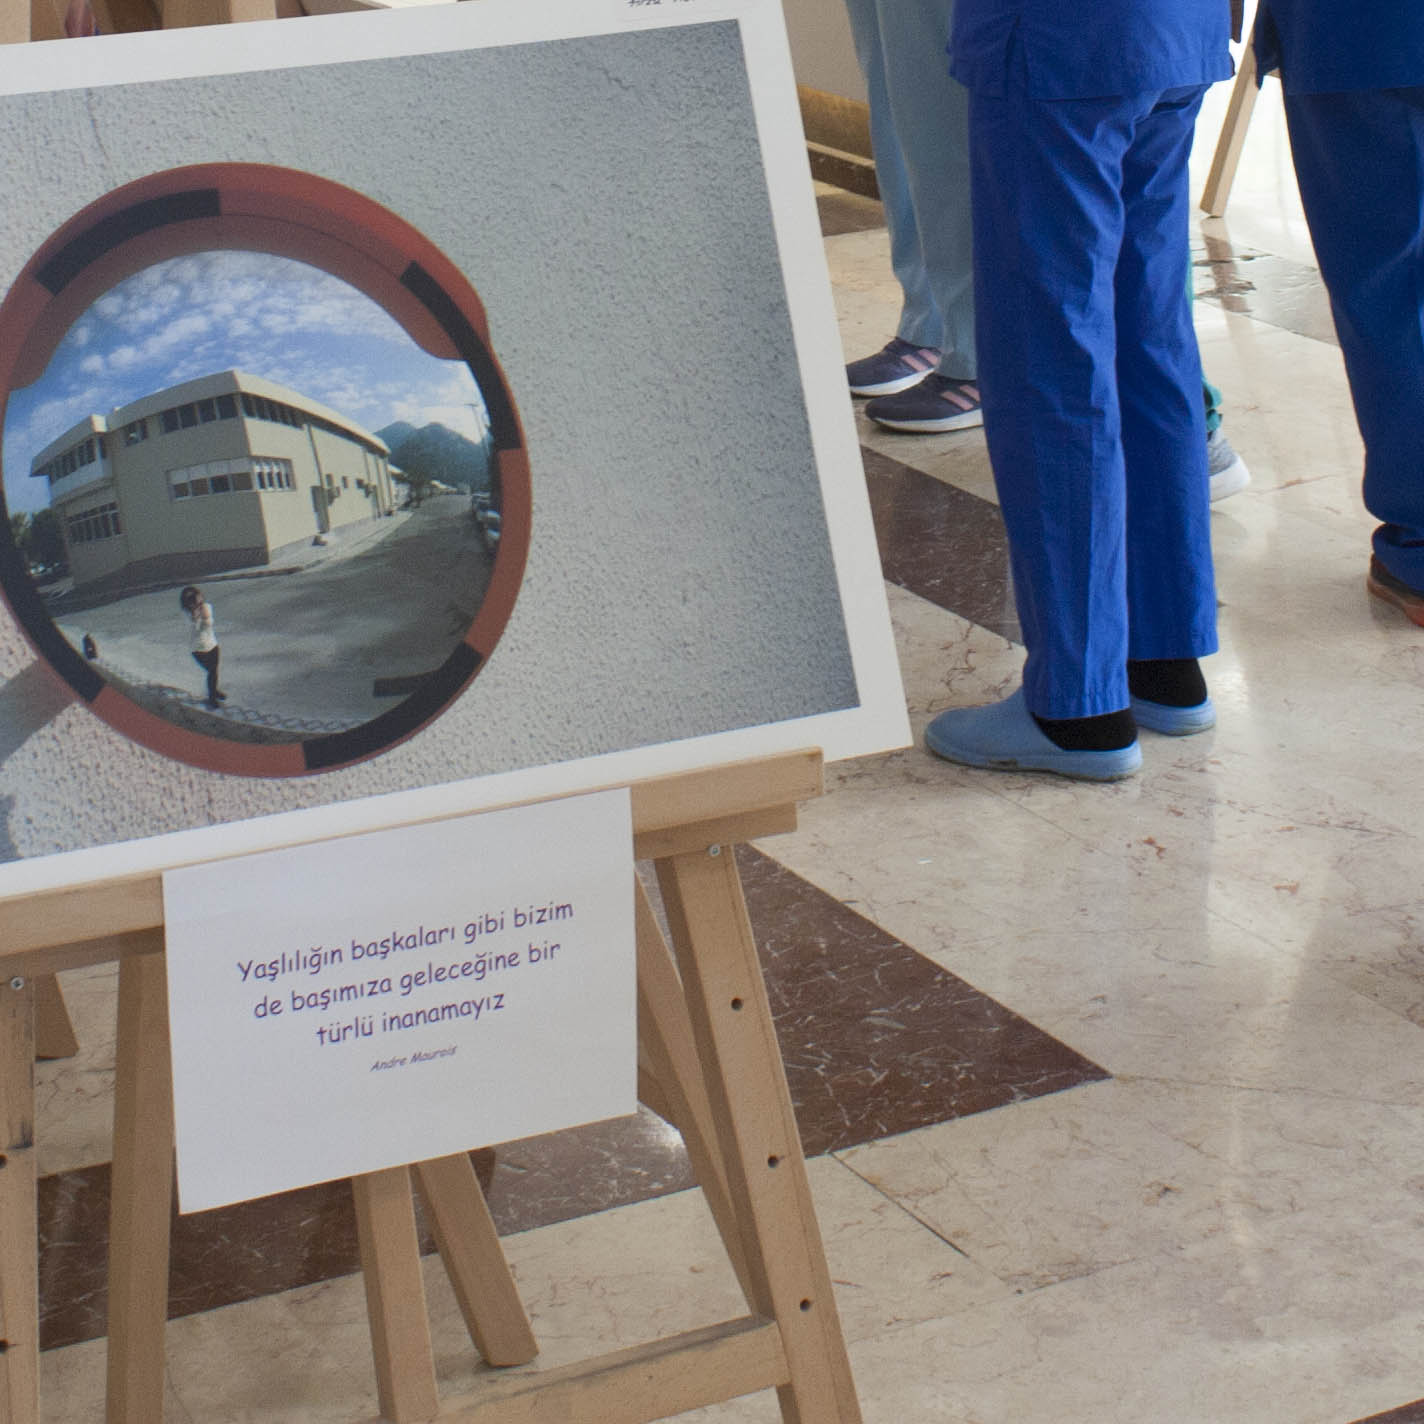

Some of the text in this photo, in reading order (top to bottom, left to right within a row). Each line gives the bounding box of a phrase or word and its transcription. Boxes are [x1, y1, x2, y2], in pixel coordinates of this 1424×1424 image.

[237, 901, 574, 982] Yaşlılığın başkaları gibi bizim
[254, 940, 560, 1019] de başımıza geleceğine bir
[316, 993, 505, 1046] türlü inanamayız
